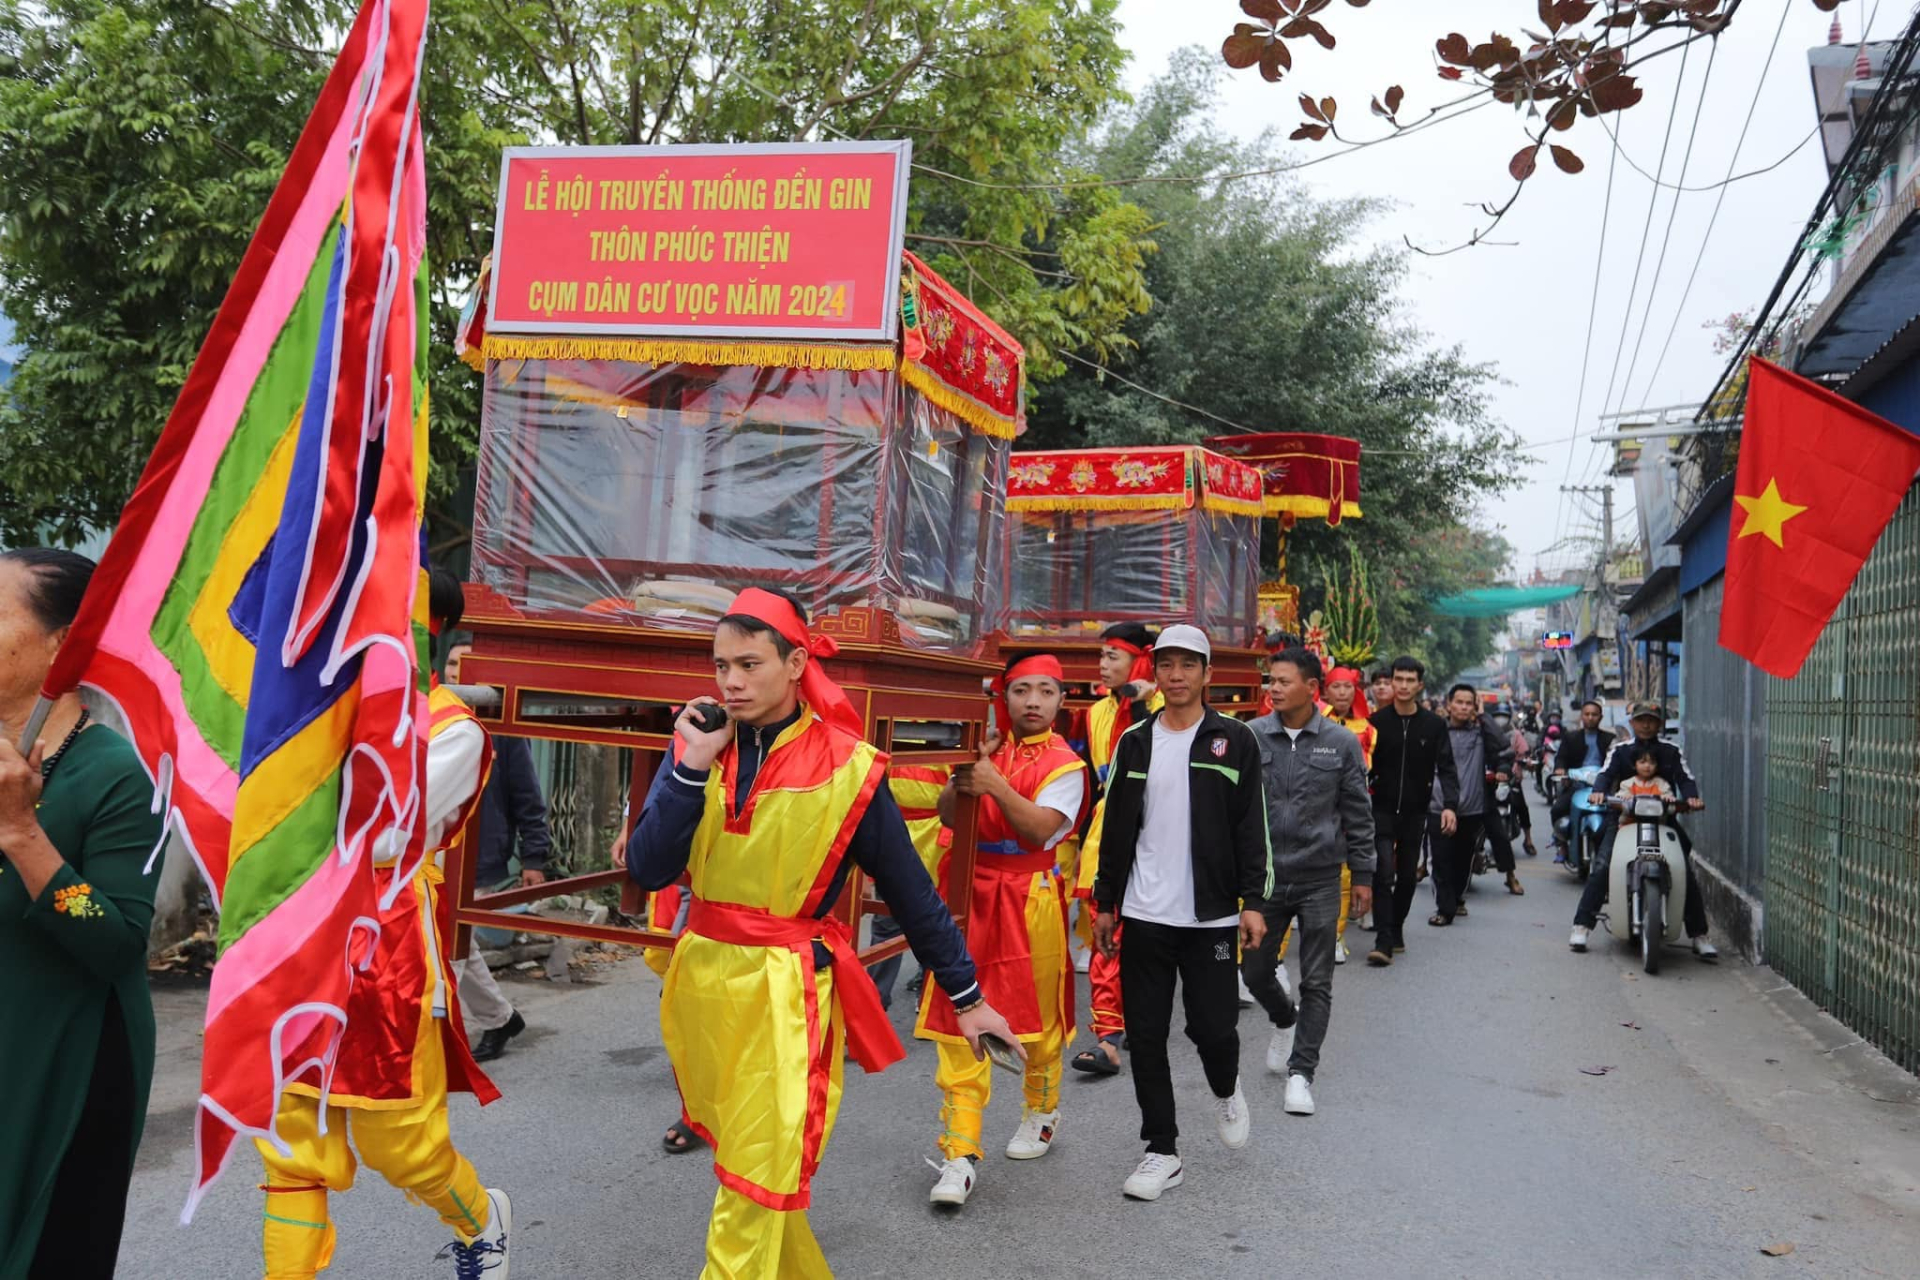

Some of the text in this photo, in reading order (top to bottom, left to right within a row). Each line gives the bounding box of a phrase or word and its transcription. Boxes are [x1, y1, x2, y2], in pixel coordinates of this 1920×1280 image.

[524, 167, 872, 218] LỄ HỘI TRUYỀN THỐNG ĐỀN GIN
[590, 225, 791, 269] THÔN PHÚC THIỆN
[529, 276, 846, 321] CỤM DÂN CƯ VỌC NĂM 2024
